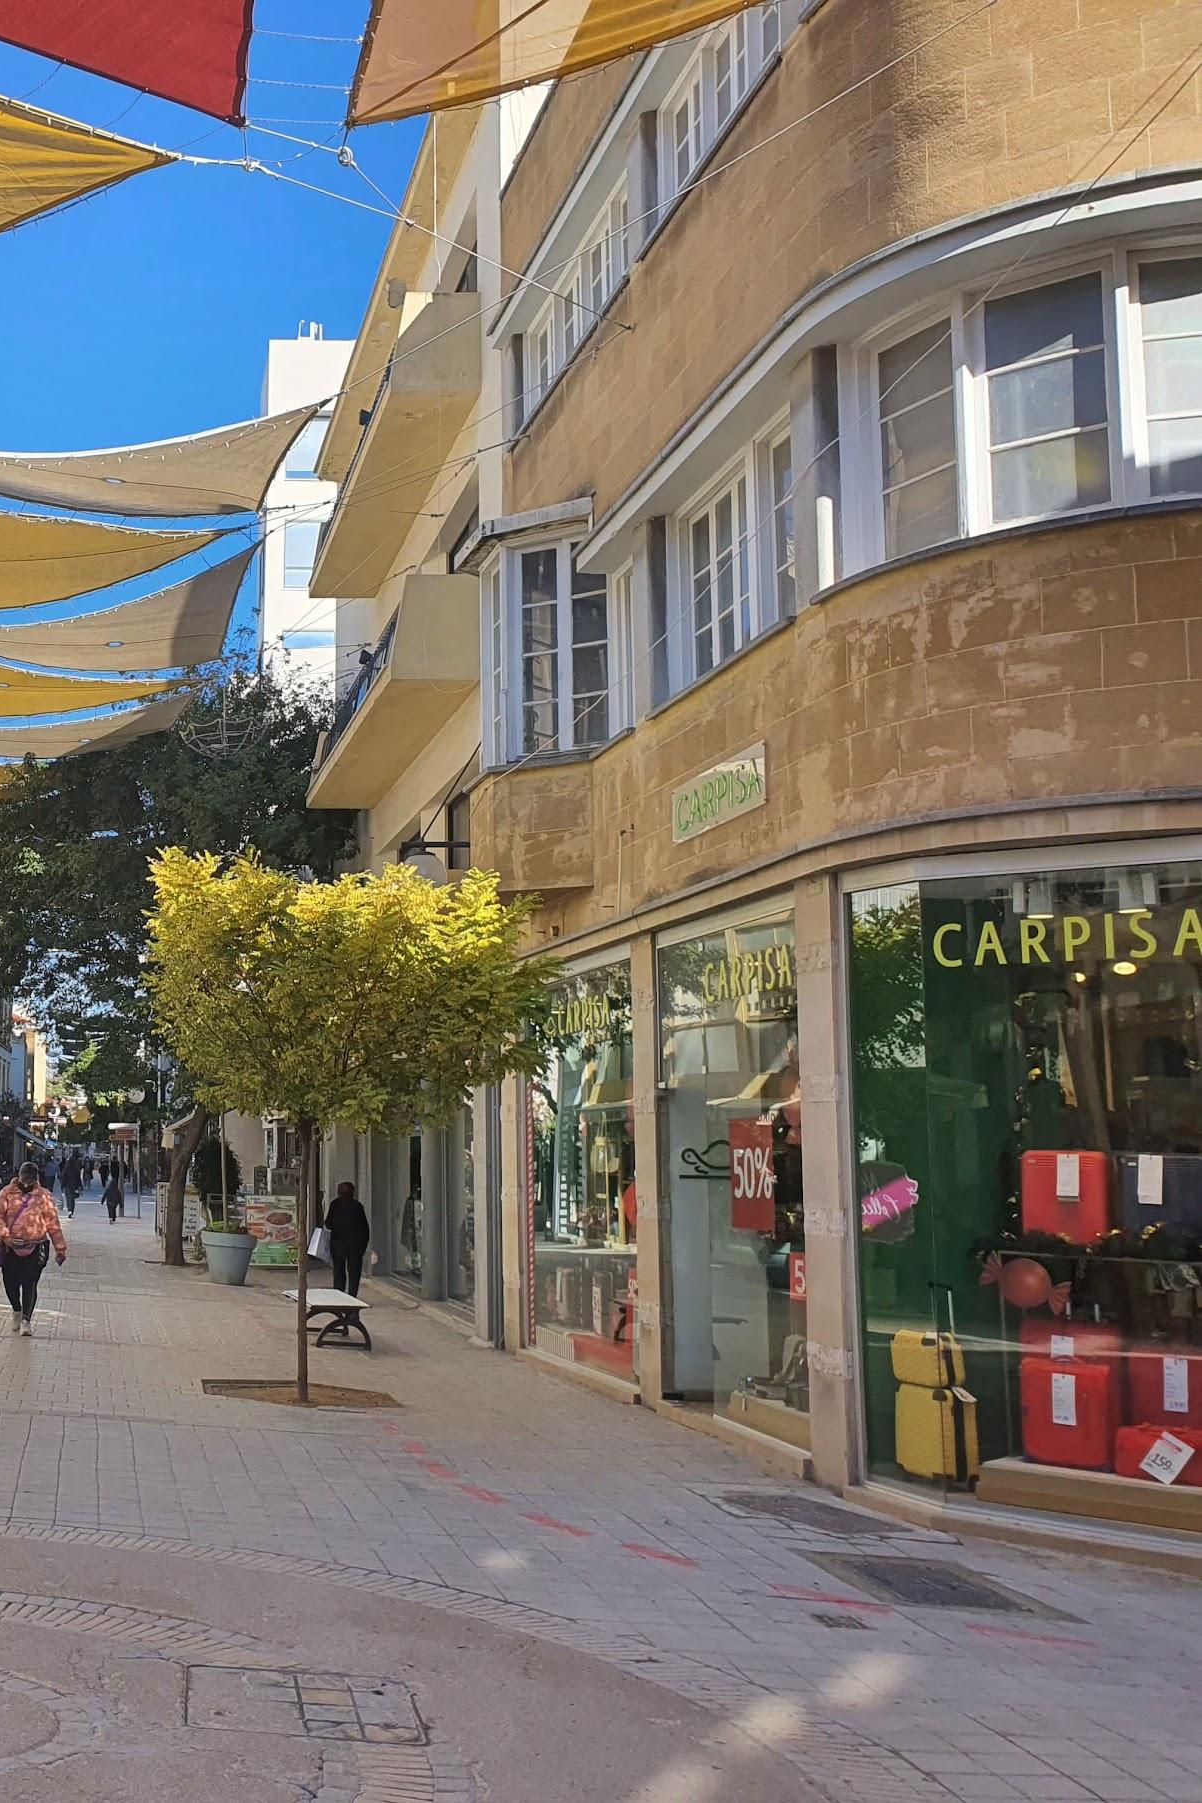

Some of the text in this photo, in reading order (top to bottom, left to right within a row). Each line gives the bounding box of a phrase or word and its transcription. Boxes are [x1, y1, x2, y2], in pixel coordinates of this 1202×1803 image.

[676, 757, 761, 832] CARPISA
[932, 907, 1202, 968] CARPISA
[703, 944, 793, 1002] CARPISA
[558, 992, 610, 1036] CARPISA
[732, 1147, 774, 1199] 50%
